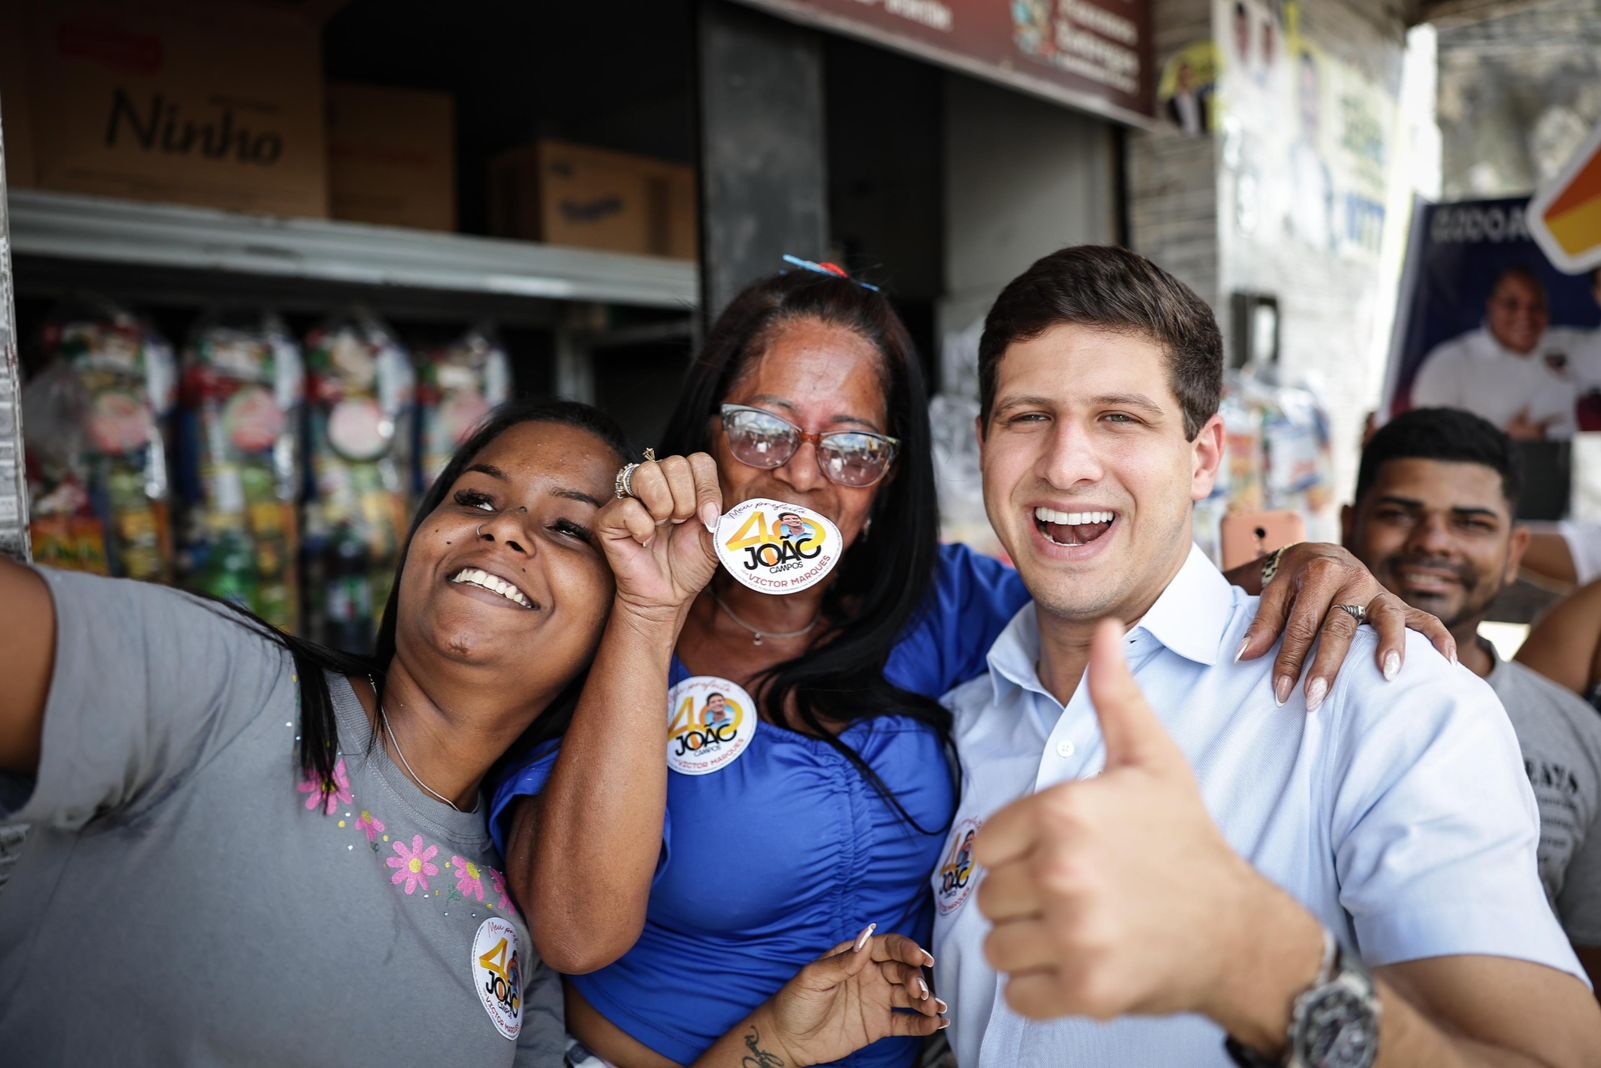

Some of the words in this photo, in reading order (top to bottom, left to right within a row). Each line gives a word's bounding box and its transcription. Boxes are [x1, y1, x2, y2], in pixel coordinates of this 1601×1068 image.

[106, 90, 282, 166] Ninho
[725, 511, 826, 565] 40
[748, 573, 788, 588] VICTOR
[791, 555, 831, 586] MARQUES
[769, 562, 804, 574] CAMPOS
